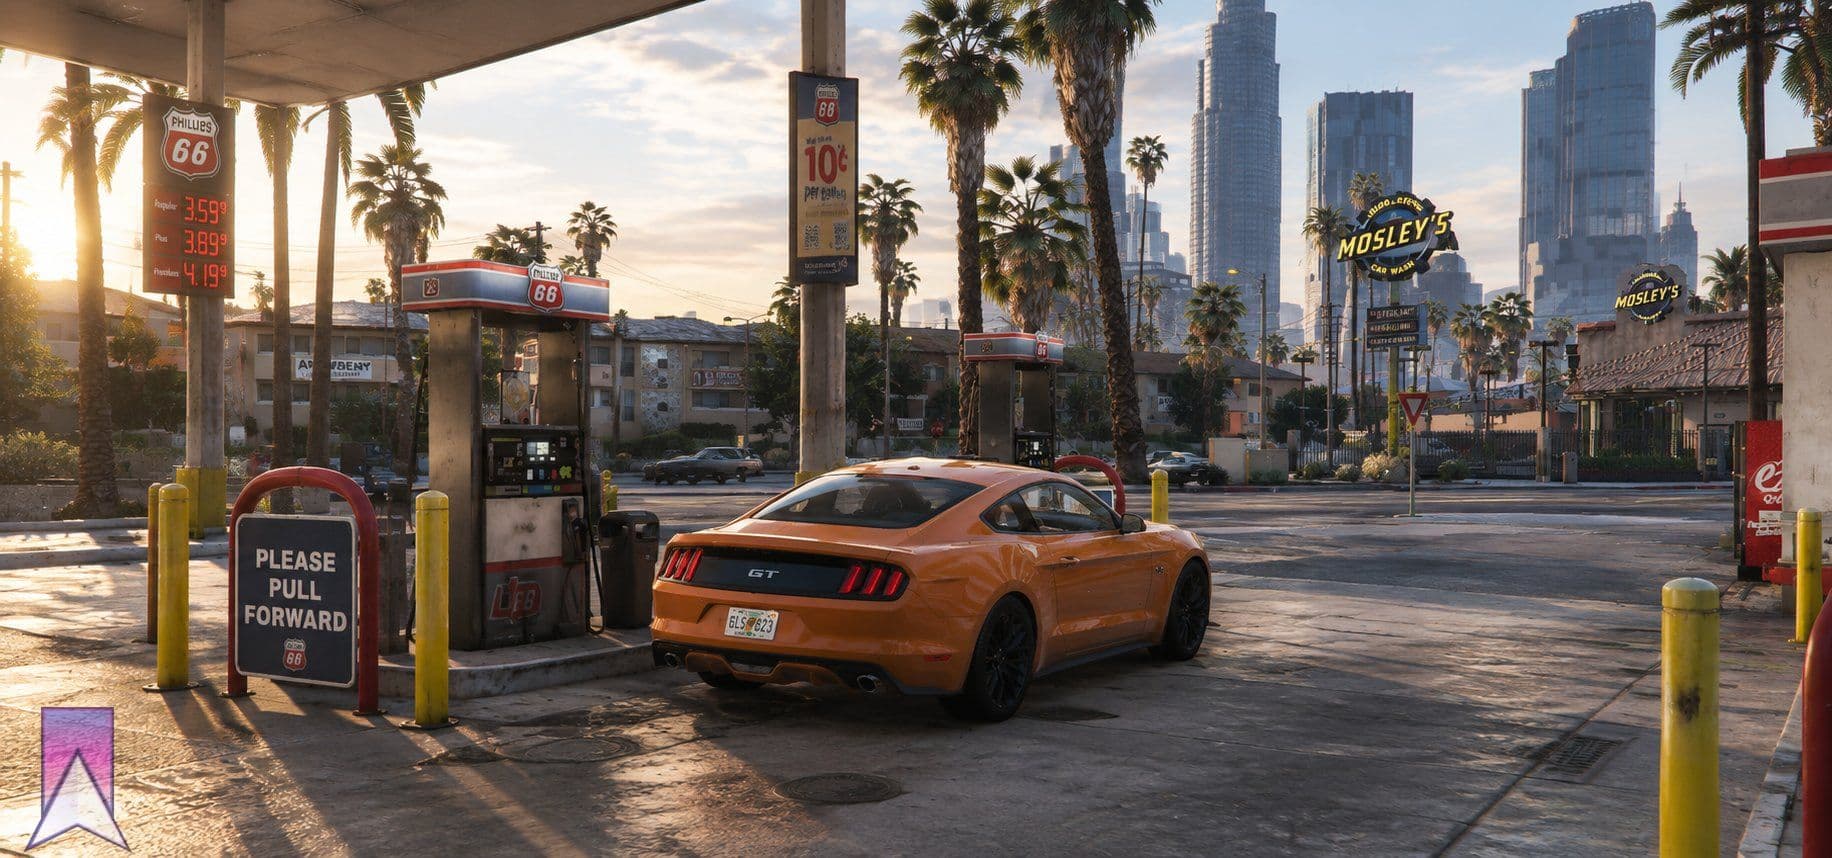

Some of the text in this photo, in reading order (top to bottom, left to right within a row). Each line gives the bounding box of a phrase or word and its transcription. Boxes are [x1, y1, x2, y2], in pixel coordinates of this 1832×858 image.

[172, 138, 210, 166] 66
[1337, 211, 1450, 260] MOSLEY'S
[533, 284, 558, 303] 66
[1614, 285, 1679, 309] MOSLEY'S
[255, 548, 336, 573] PLEASE
[748, 568, 780, 579] GT
[269, 577, 322, 601] PULL
[244, 604, 347, 632] FORWARD
